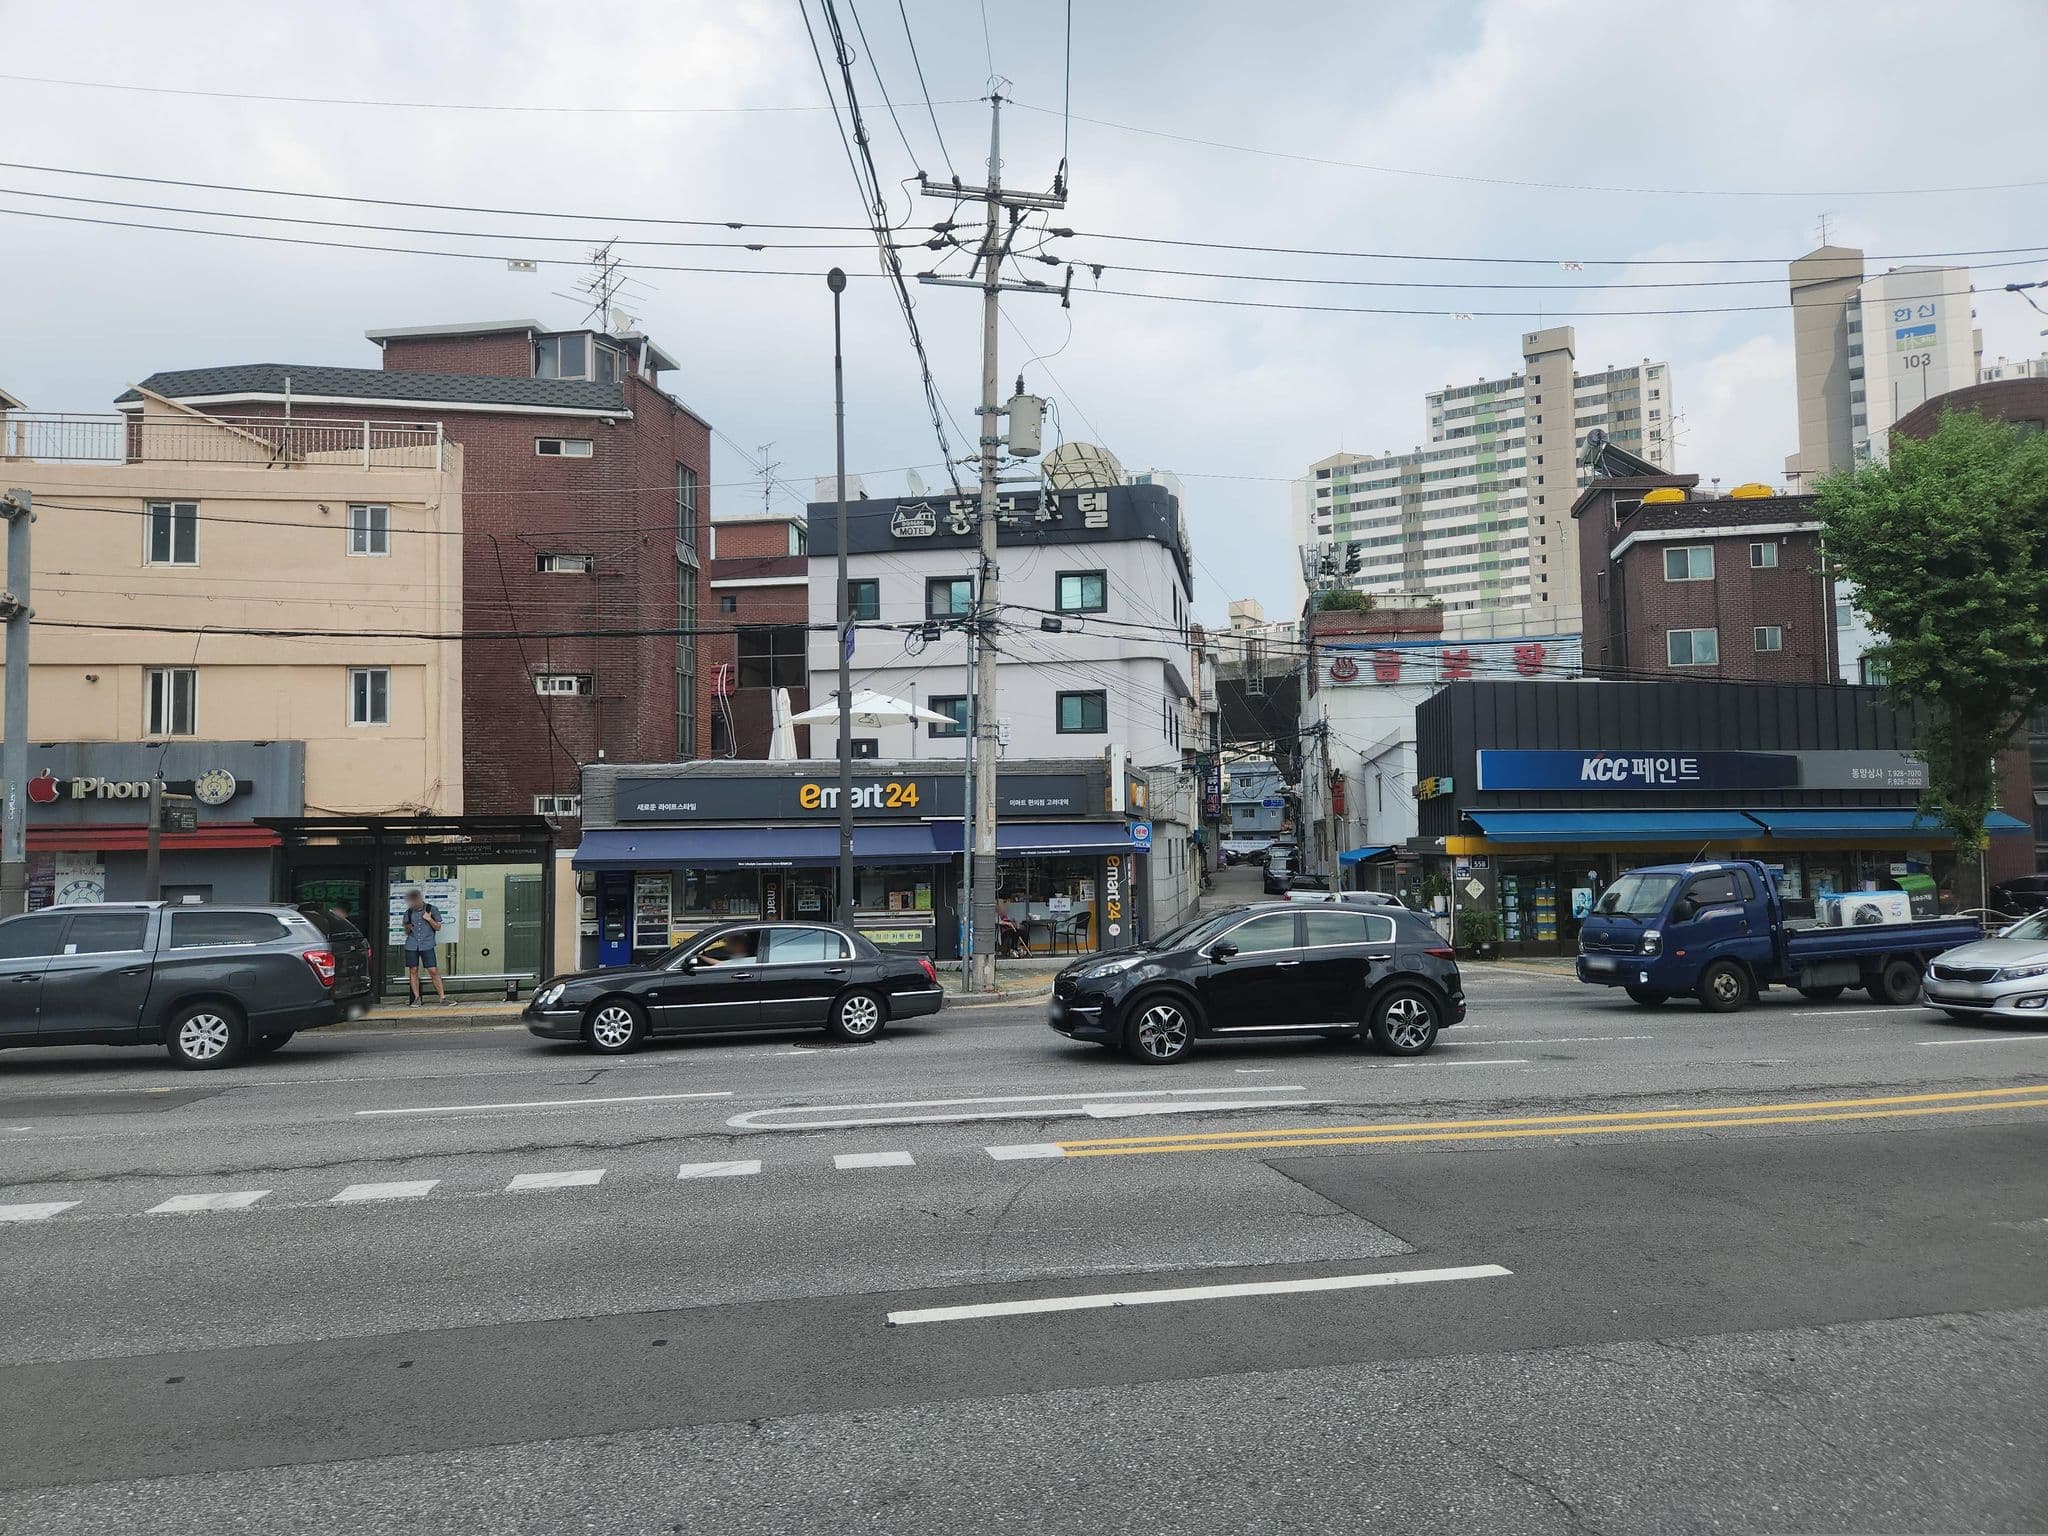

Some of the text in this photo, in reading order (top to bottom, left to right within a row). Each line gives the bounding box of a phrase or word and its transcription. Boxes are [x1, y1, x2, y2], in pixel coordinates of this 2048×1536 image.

[1893, 303, 1936, 323] 한신
[1903, 352, 1932, 369] 103
[900, 526, 929, 536] MOTEL
[1581, 757, 1701, 784] KCC 페인트
[800, 782, 920, 809] emart24
[1106, 855, 1121, 921] emart24
